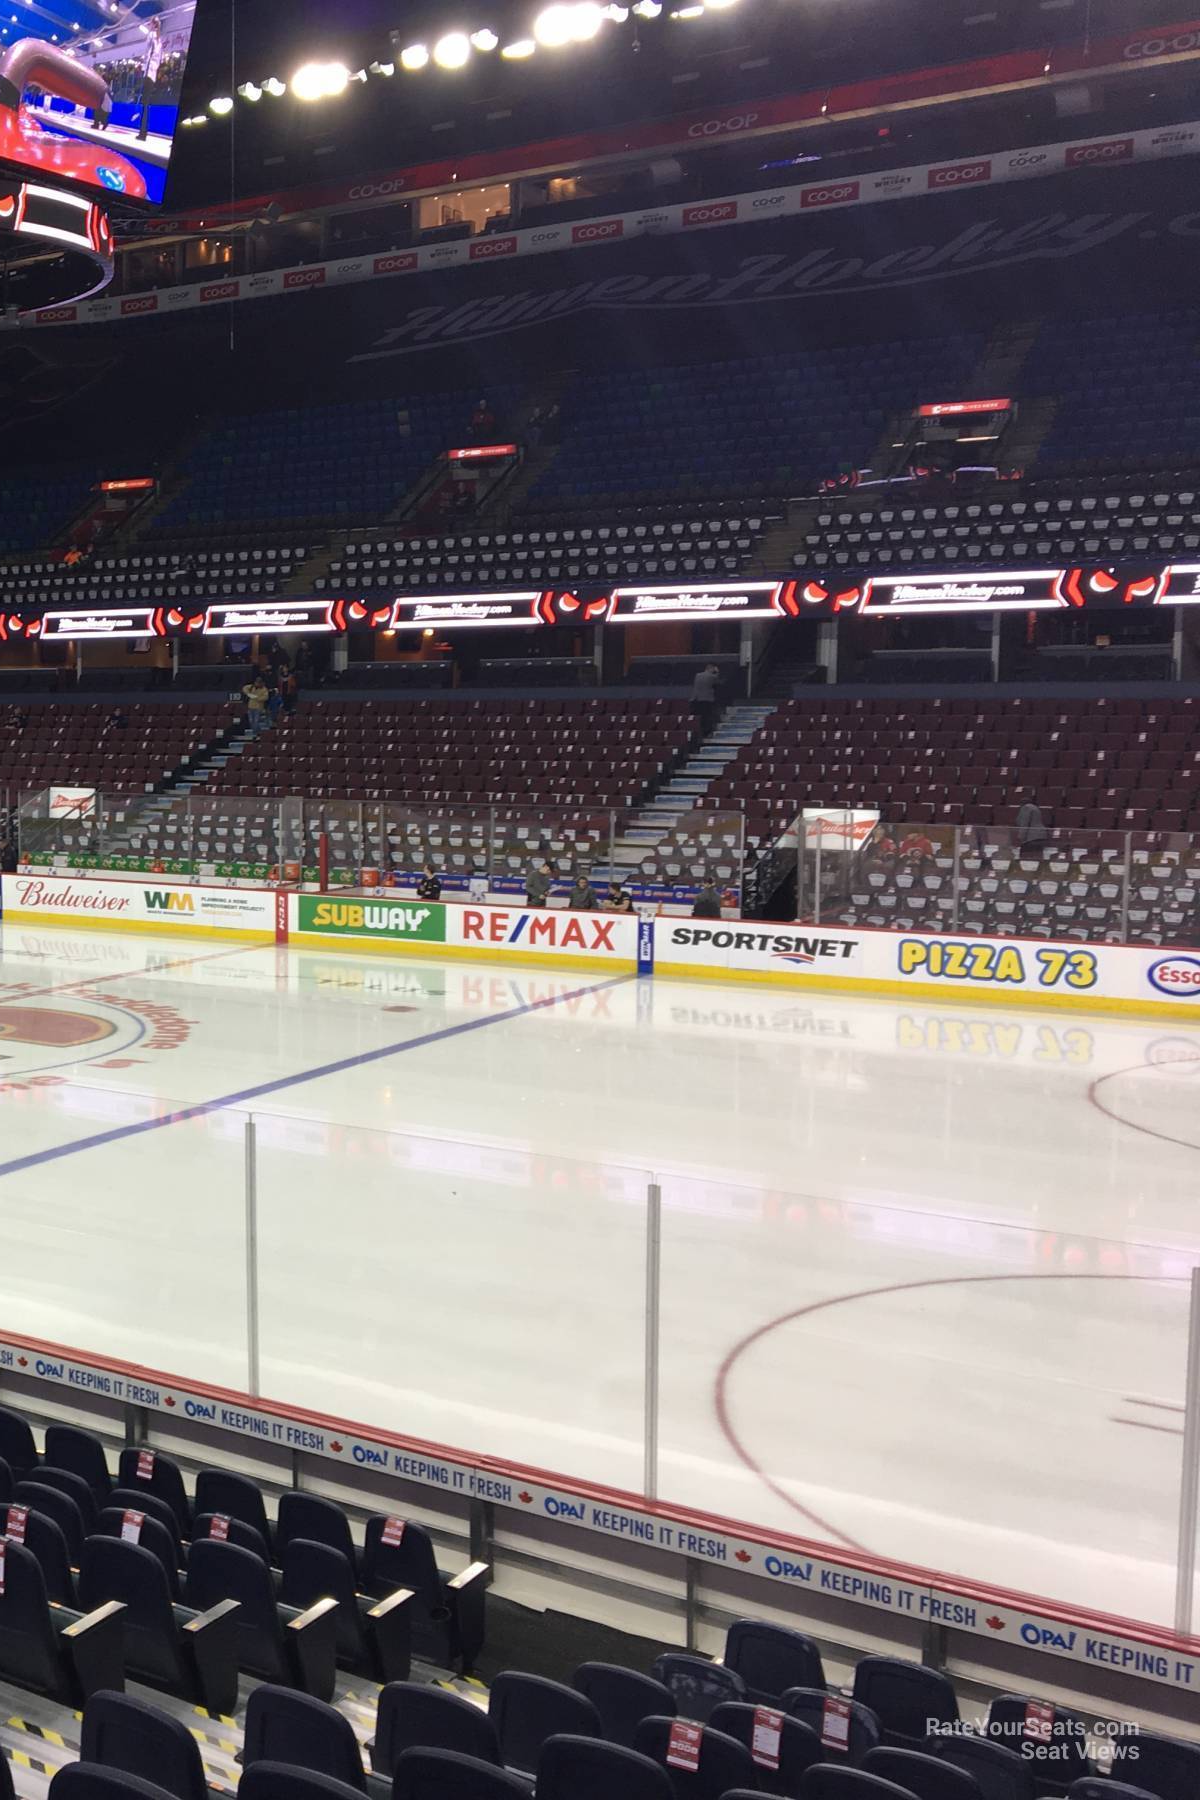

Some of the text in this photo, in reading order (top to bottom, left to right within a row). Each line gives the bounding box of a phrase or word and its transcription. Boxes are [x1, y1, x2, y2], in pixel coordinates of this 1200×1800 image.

[15, 880, 130, 911] Budweiser
[143, 890, 196, 912] WM
[312, 903, 432, 932] SUBWAY
[463, 910, 616, 951] RE/MAX
[671, 928, 859, 958] SPORTSNET
[898, 938, 1098, 989] PIZZA 73
[1158, 965, 1200, 984] Esso
[35, 1360, 160, 1407] OPA! KEEPING IT FRESH
[184, 1400, 324, 1451] OPA! KEEPING IT FRESH
[352, 1444, 512, 1502] OPA! KEEPING IT FRESH
[543, 1496, 727, 1561] OPA! KEEPING IT FRESH
[764, 1555, 976, 1628] OPA! KEEPING IT FRESH
[1020, 1622, 1194, 1683] OPA! KEEPING IT
